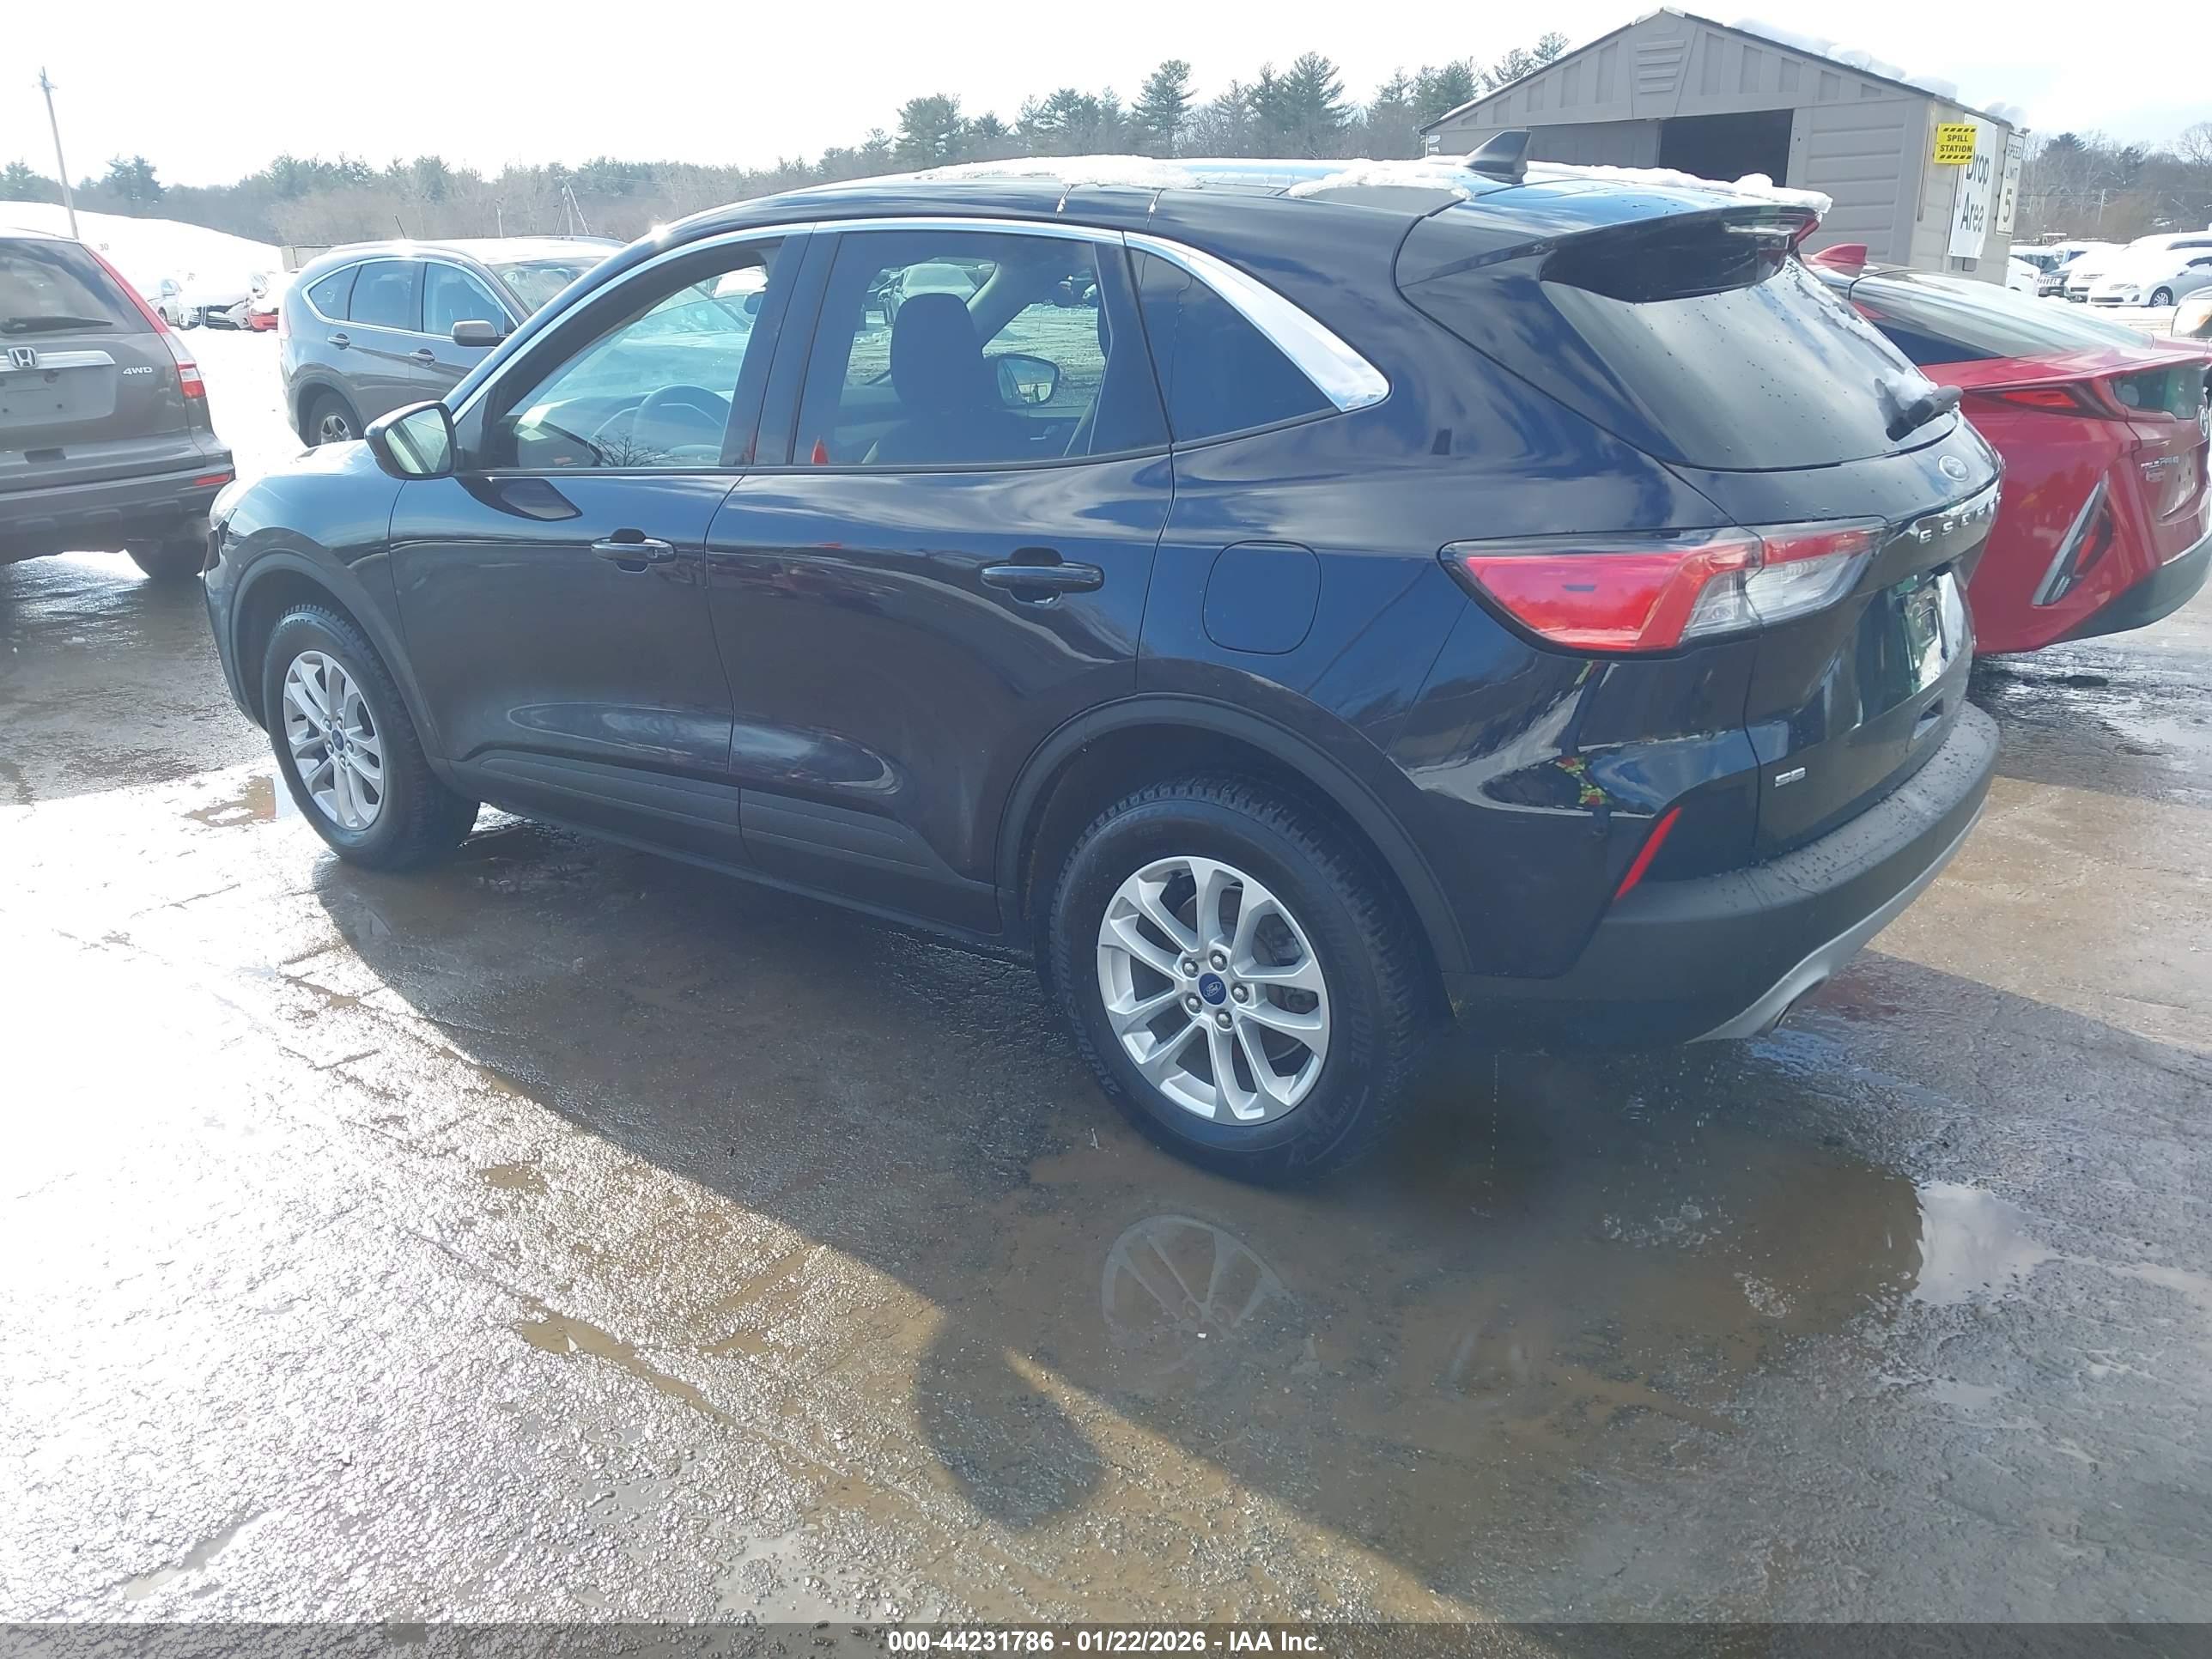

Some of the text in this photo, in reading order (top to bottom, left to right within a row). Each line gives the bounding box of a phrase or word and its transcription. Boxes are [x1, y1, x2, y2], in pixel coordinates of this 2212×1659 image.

[1947, 134, 1969, 143] SPILL
[1940, 144, 1973, 153] STATION
[2008, 143, 2022, 160] SPEED
[1966, 152, 1990, 192] Drop
[2002, 187, 2013, 223] 5
[1960, 192, 1984, 233] Area
[99, 243, 109, 252] 30
[123, 366, 153, 375] 4WD
